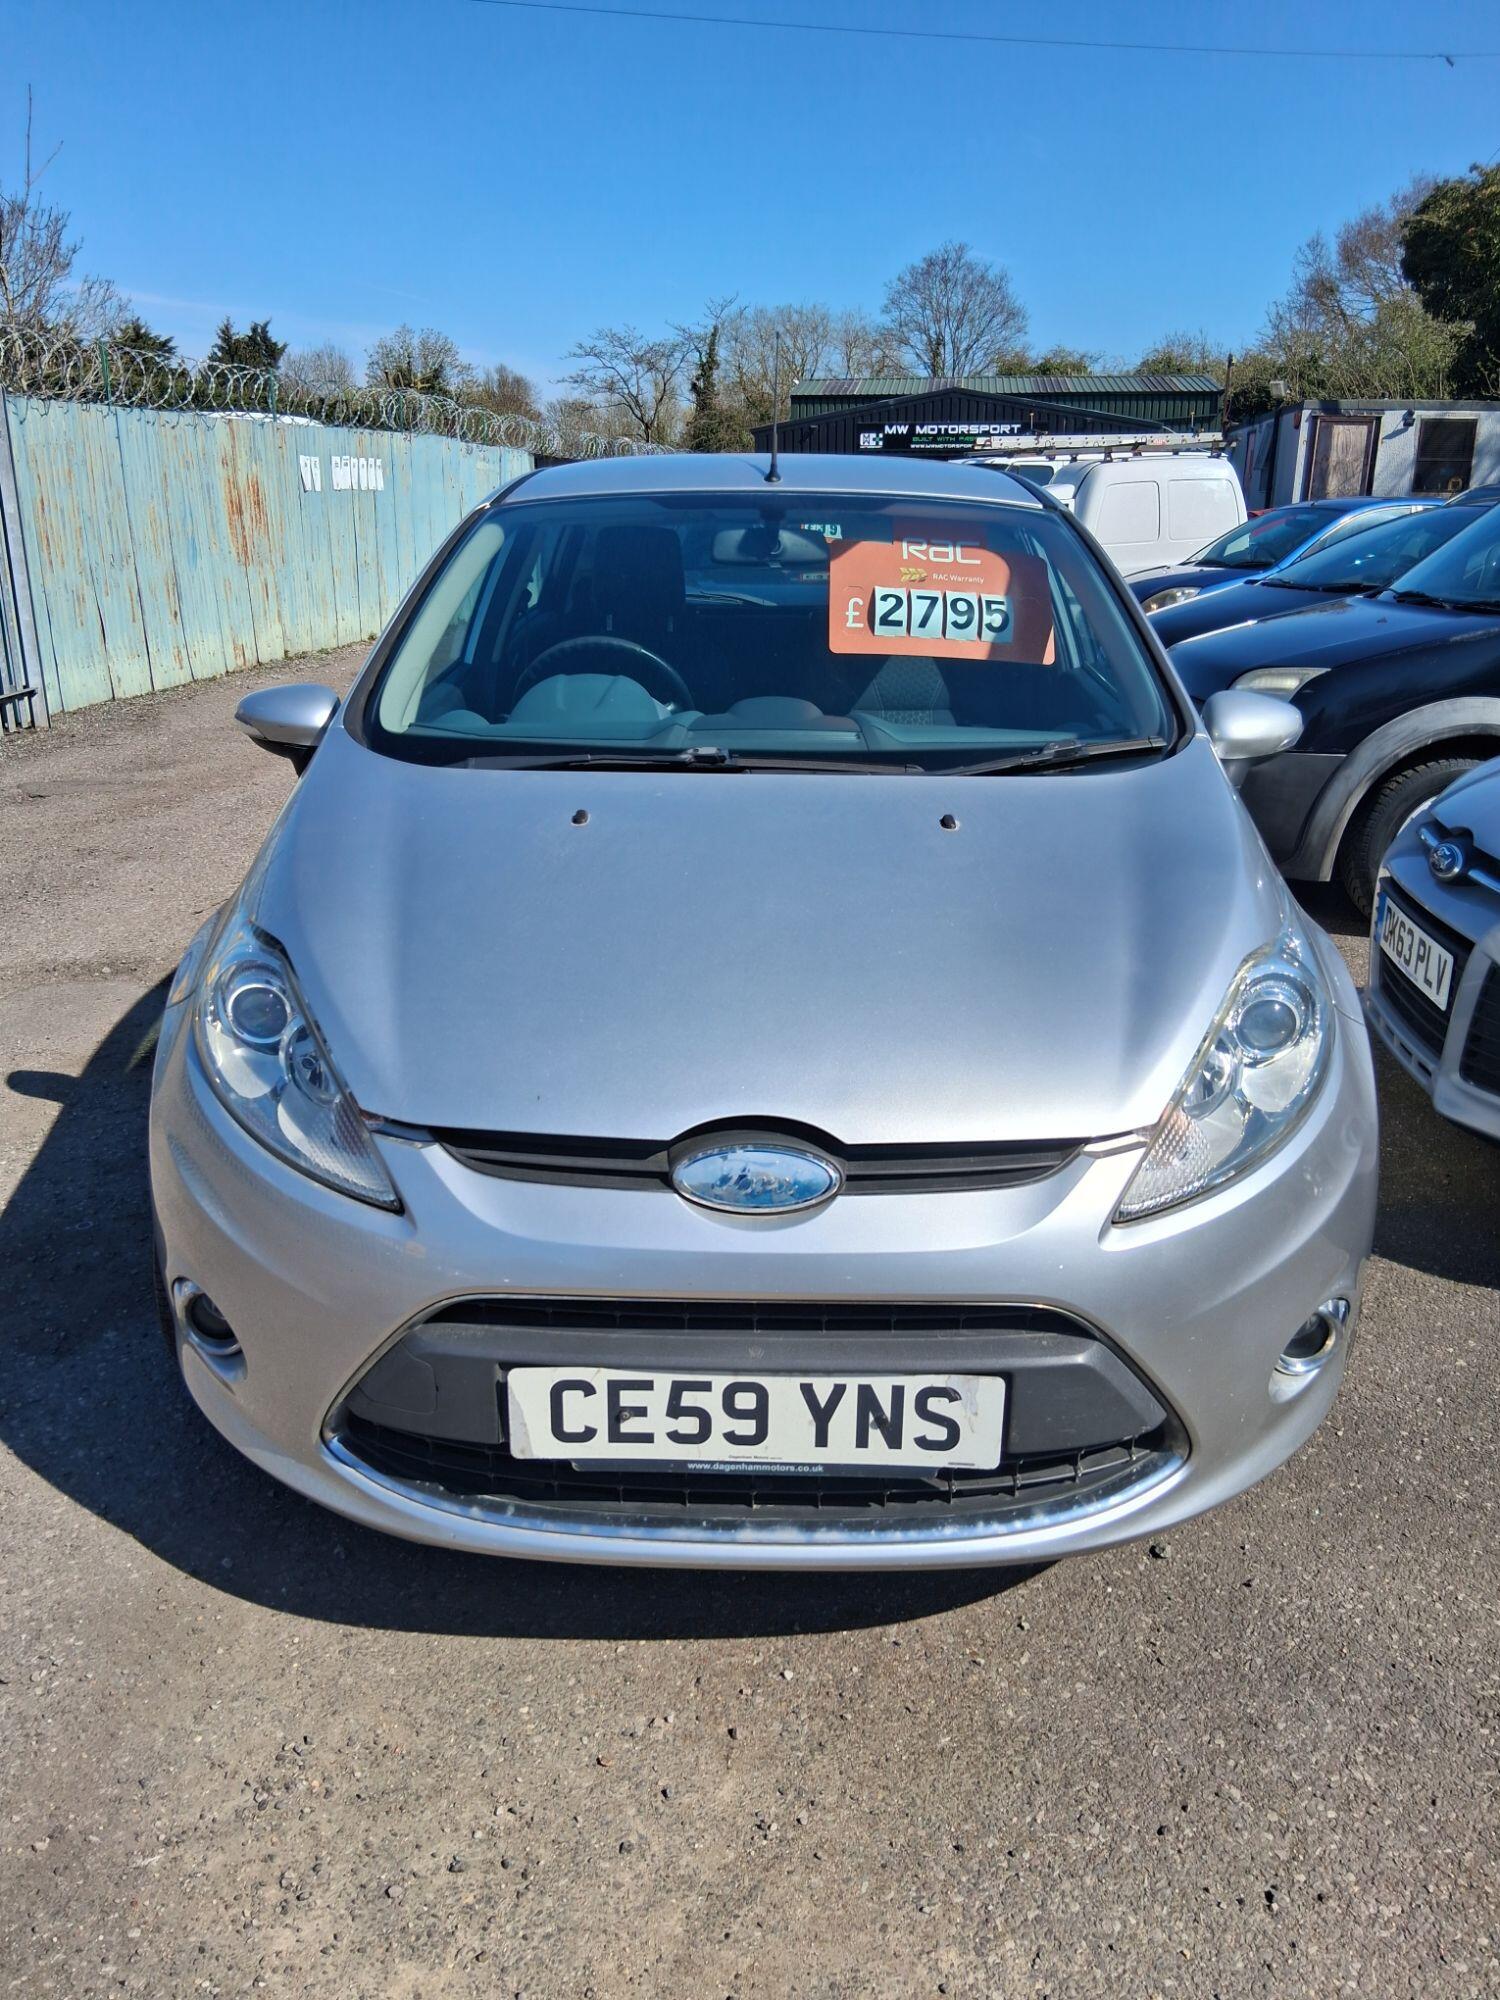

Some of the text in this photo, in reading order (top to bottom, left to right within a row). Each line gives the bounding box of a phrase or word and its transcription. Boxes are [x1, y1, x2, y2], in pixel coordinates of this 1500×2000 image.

[884, 424, 1021, 434] MW MOTORSPORT
[932, 573, 985, 584] RAC Warranty
[1382, 905, 1448, 996] DK63 PLV
[549, 1379, 963, 1452] CE59 YNS
[687, 1462, 824, 1473] www.dagenhammotors.co.uk
